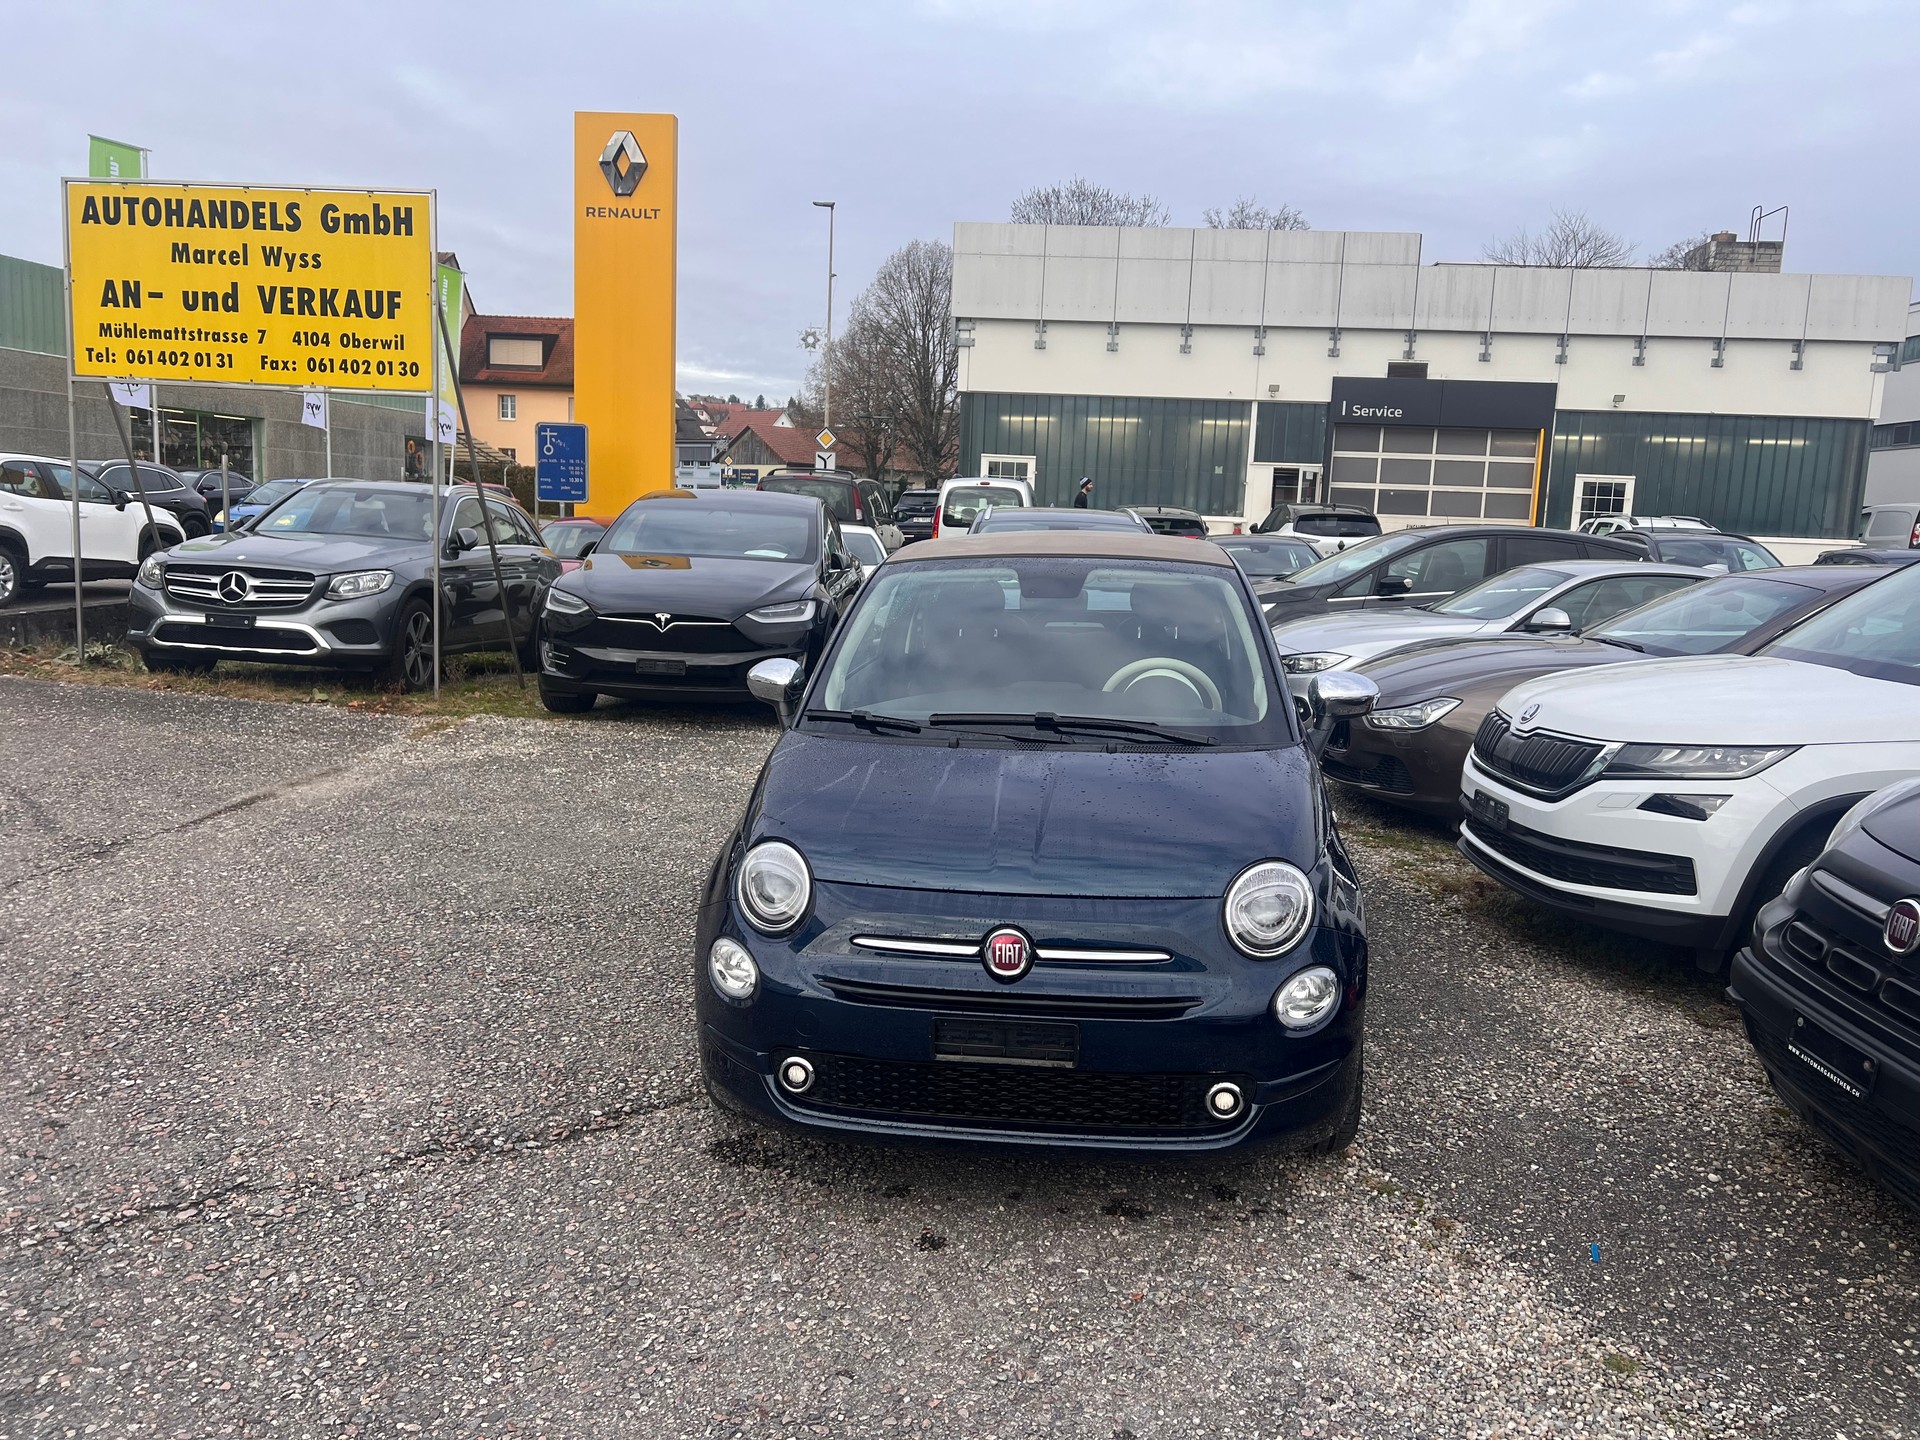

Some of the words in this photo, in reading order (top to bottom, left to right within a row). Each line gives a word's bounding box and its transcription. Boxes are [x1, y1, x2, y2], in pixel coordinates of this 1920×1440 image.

[81, 195, 302, 233] AUTOHANDELS
[320, 203, 413, 237] GmbH
[585, 206, 661, 220] RENAULT
[171, 242, 249, 266] Marcel
[260, 245, 322, 273] Wyss
[181, 281, 239, 313] und
[256, 285, 402, 320] VERKAUF
[99, 322, 249, 344] Mühlemattstrasse
[257, 329, 267, 345] 7
[292, 331, 331, 347] 4104
[339, 332, 405, 351] Oberwil
[85, 346, 117, 364] Tel:
[260, 355, 297, 372] Fax:
[1352, 404, 1403, 418] Service
[1890, 912, 1917, 943] FIAT
[995, 943, 1021, 964] FIAT
